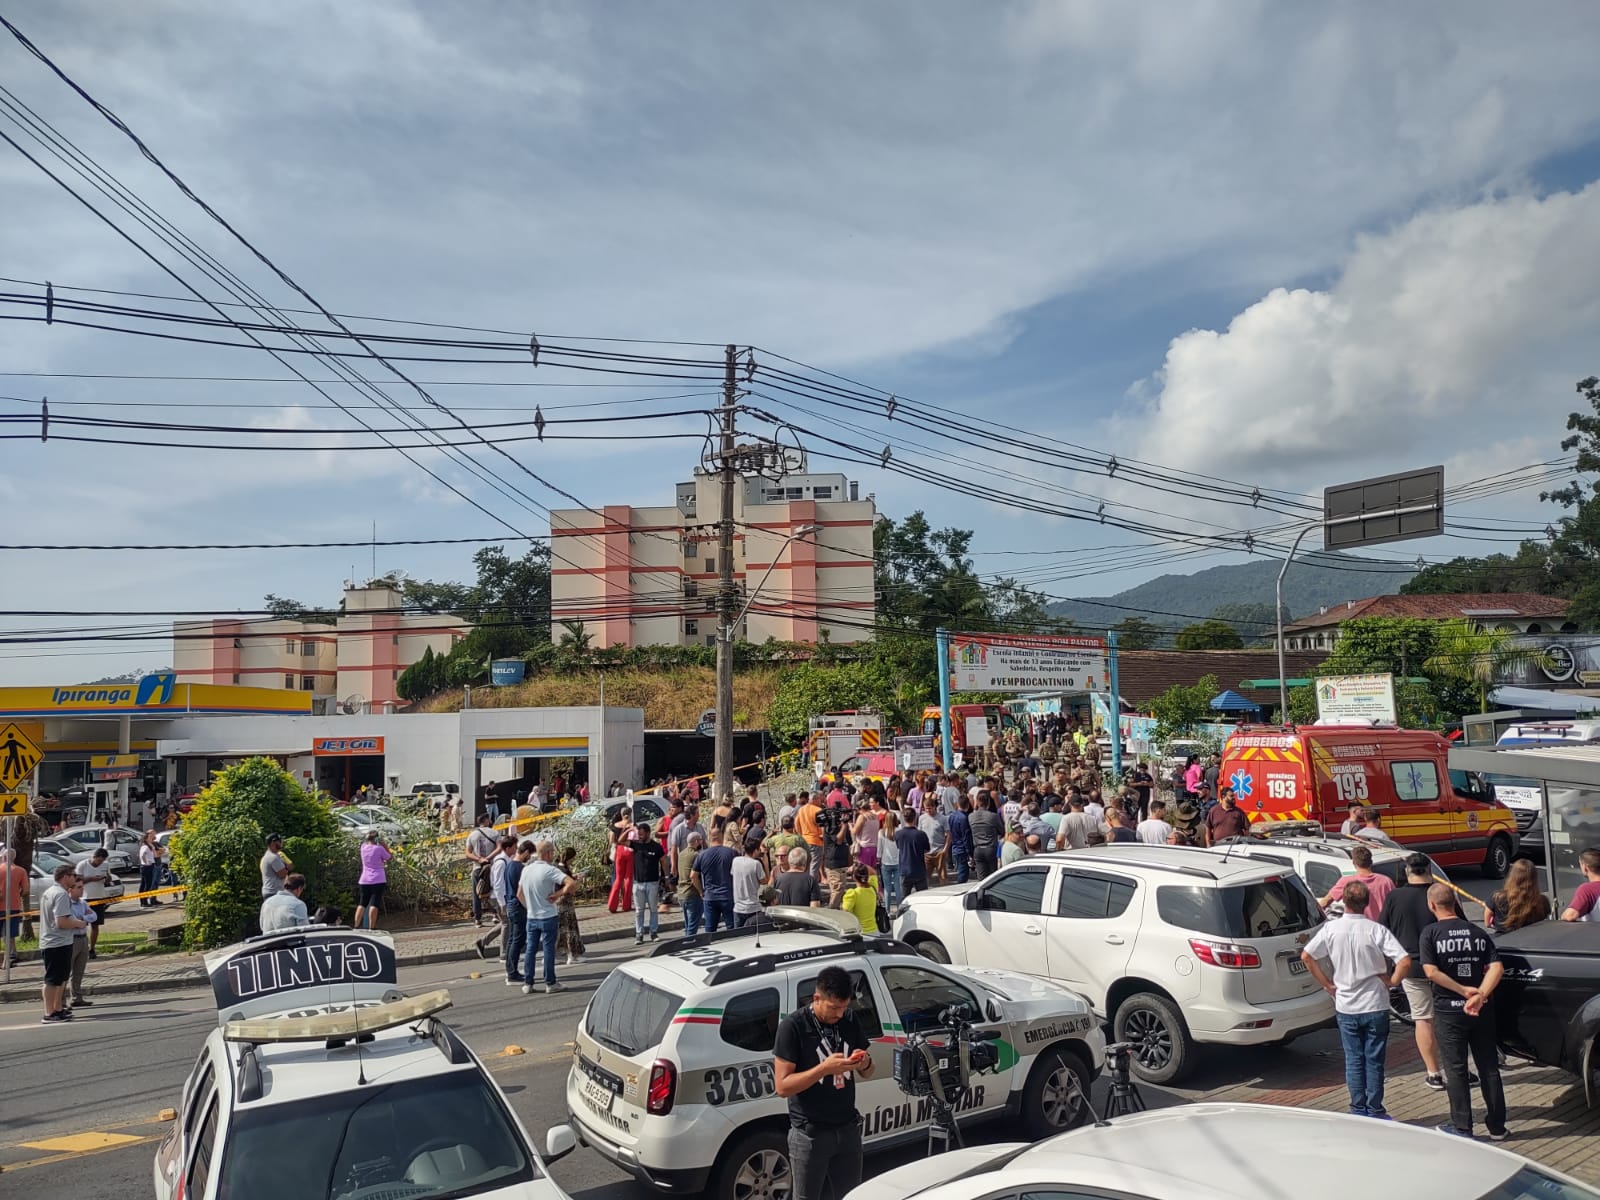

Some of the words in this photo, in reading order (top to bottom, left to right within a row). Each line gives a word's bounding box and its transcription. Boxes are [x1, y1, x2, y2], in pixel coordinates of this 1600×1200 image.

[1070, 639, 1099, 647] PASTOR
[991, 677, 1075, 687] #VEMPROCANTINHO
[52, 687, 132, 705] Ipiranga
[316, 740, 348, 750] JET
[1231, 736, 1293, 748] BOMBEIROS
[1266, 779, 1297, 800] 193
[1332, 772, 1369, 801] 193
[1448, 929, 1471, 938] SOMOS
[1436, 937, 1472, 954] NOTA
[1474, 937, 1487, 953] 10
[783, 950, 825, 961] DUSTER
[226, 940, 383, 997] CANIL
[704, 1061, 776, 1106] 3283
[863, 1102, 912, 1137] LÍCIA
